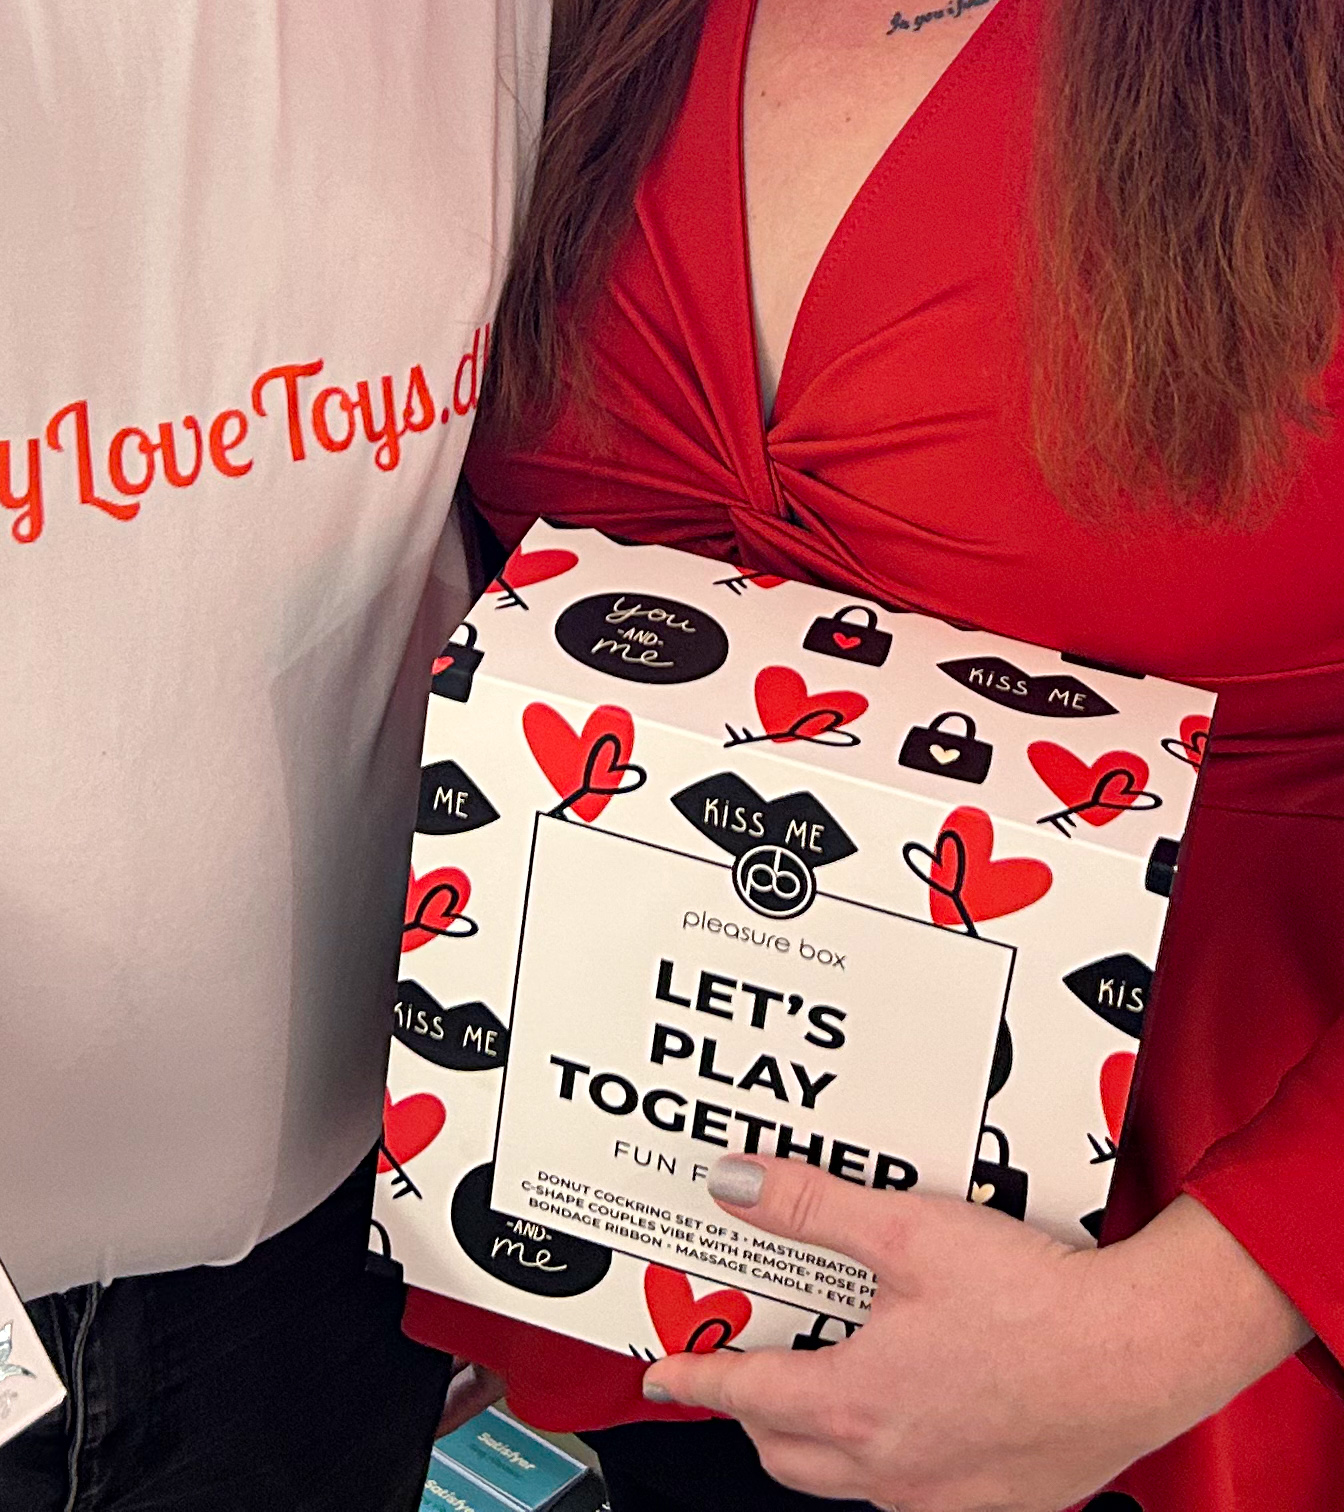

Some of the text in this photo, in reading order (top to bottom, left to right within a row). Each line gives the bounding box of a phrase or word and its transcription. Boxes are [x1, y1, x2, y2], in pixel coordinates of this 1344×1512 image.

[604, 594, 697, 635] you
[590, 636, 676, 668] me
[1048, 687, 1089, 712] ME
[432, 786, 470, 820] ME
[784, 818, 827, 855] ME
[682, 908, 848, 971] pleasure box
[655, 956, 848, 1050] LET'S
[463, 1023, 499, 1056] ME
[649, 1021, 838, 1111] PLAY
[613, 1139, 678, 1176] FUN
[520, 1180, 585, 1209] C-SHAPE
[587, 1201, 657, 1232] COUPLES
[658, 1222, 696, 1243] VIBE
[698, 1234, 739, 1257] WITH
[814, 1270, 857, 1293] ROSE
[537, 1169, 868, 1281] DONUT COCKRING SET OF 3 MASTURBATOR
[490, 1235, 568, 1273] me
[528, 1196, 601, 1230] BONDAGE
[604, 1221, 663, 1248] RIBBON
[674, 1243, 748, 1274] MASSAGE
[750, 1266, 814, 1296] CANDLE
[825, 1290, 856, 1308] EYE
